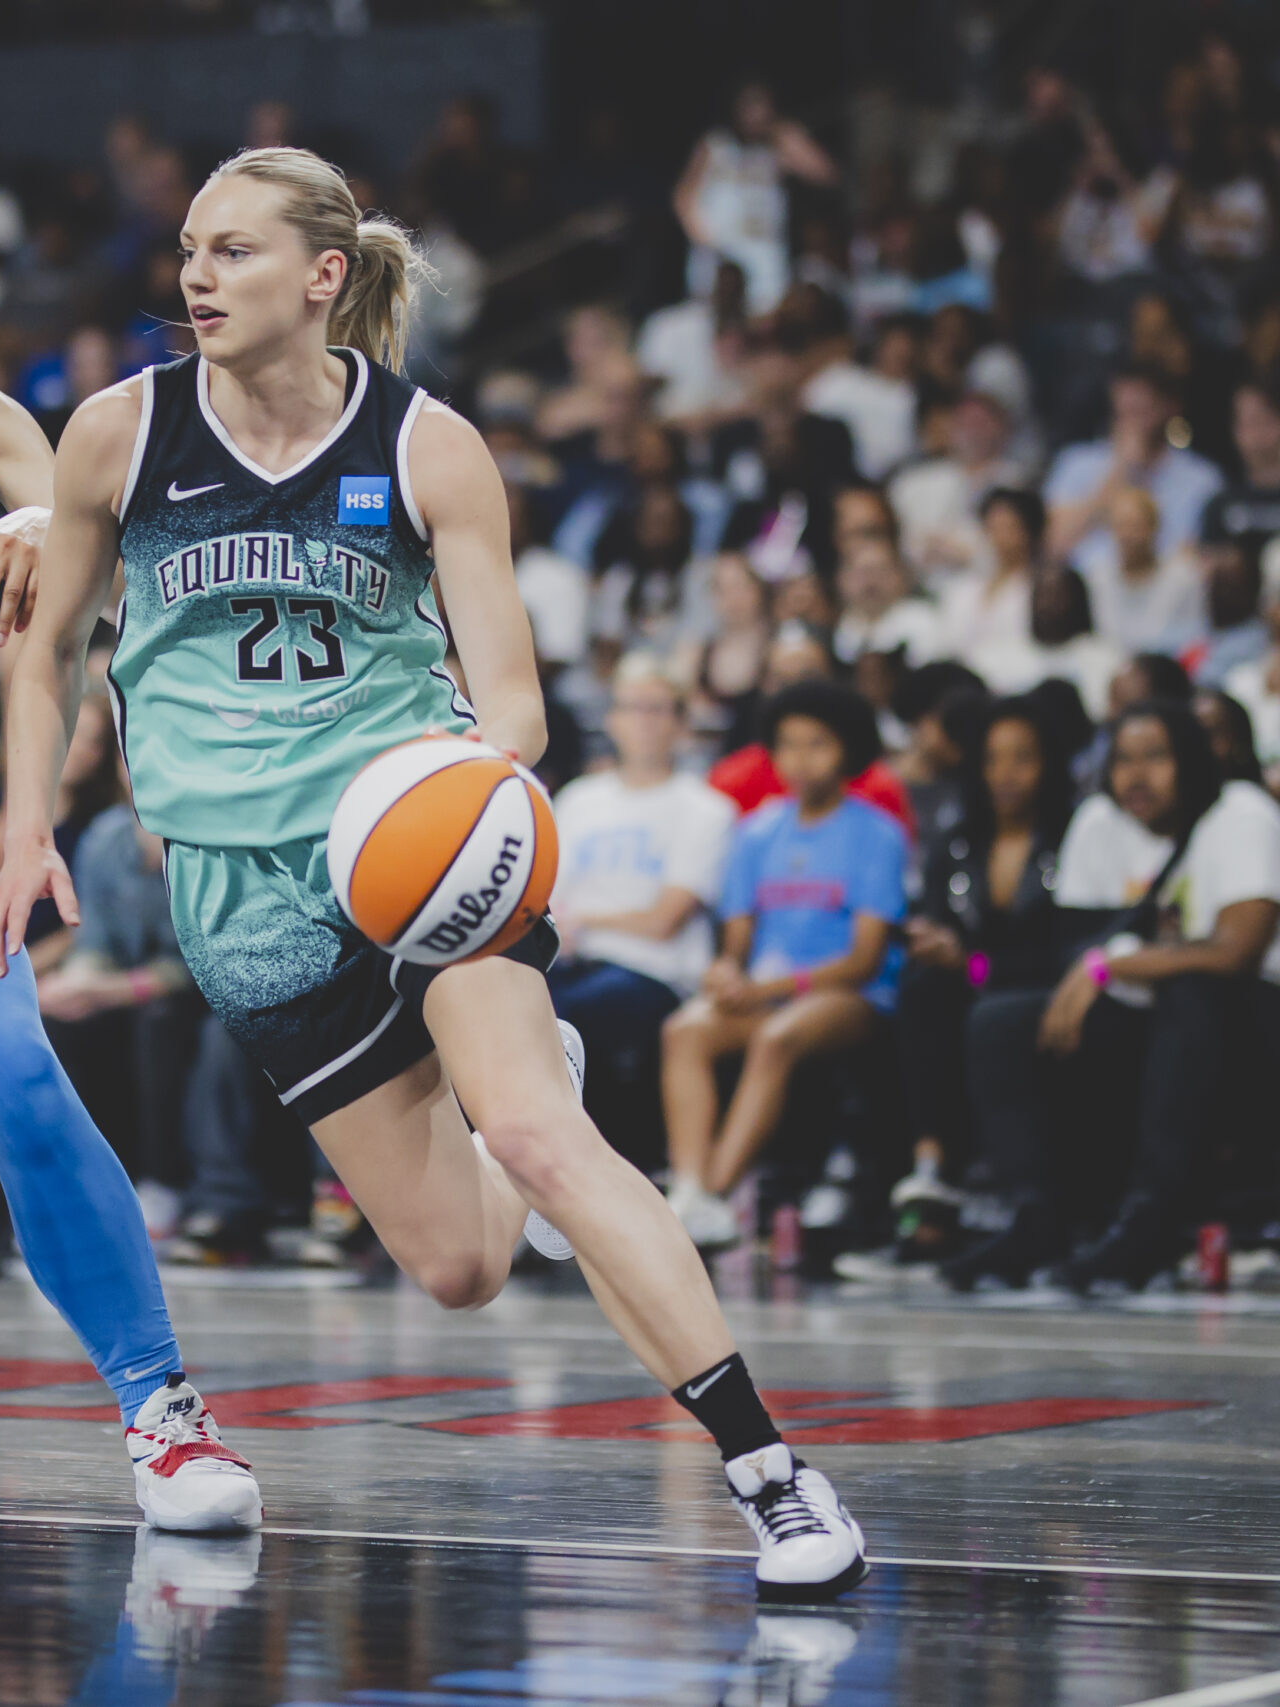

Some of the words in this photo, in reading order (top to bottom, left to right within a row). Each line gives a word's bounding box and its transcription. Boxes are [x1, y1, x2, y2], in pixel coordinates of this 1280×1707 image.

[345, 493, 385, 510] HSS
[228, 596, 350, 685] 23
[272, 687, 371, 724] Webull
[417, 834, 524, 954] Wilson
